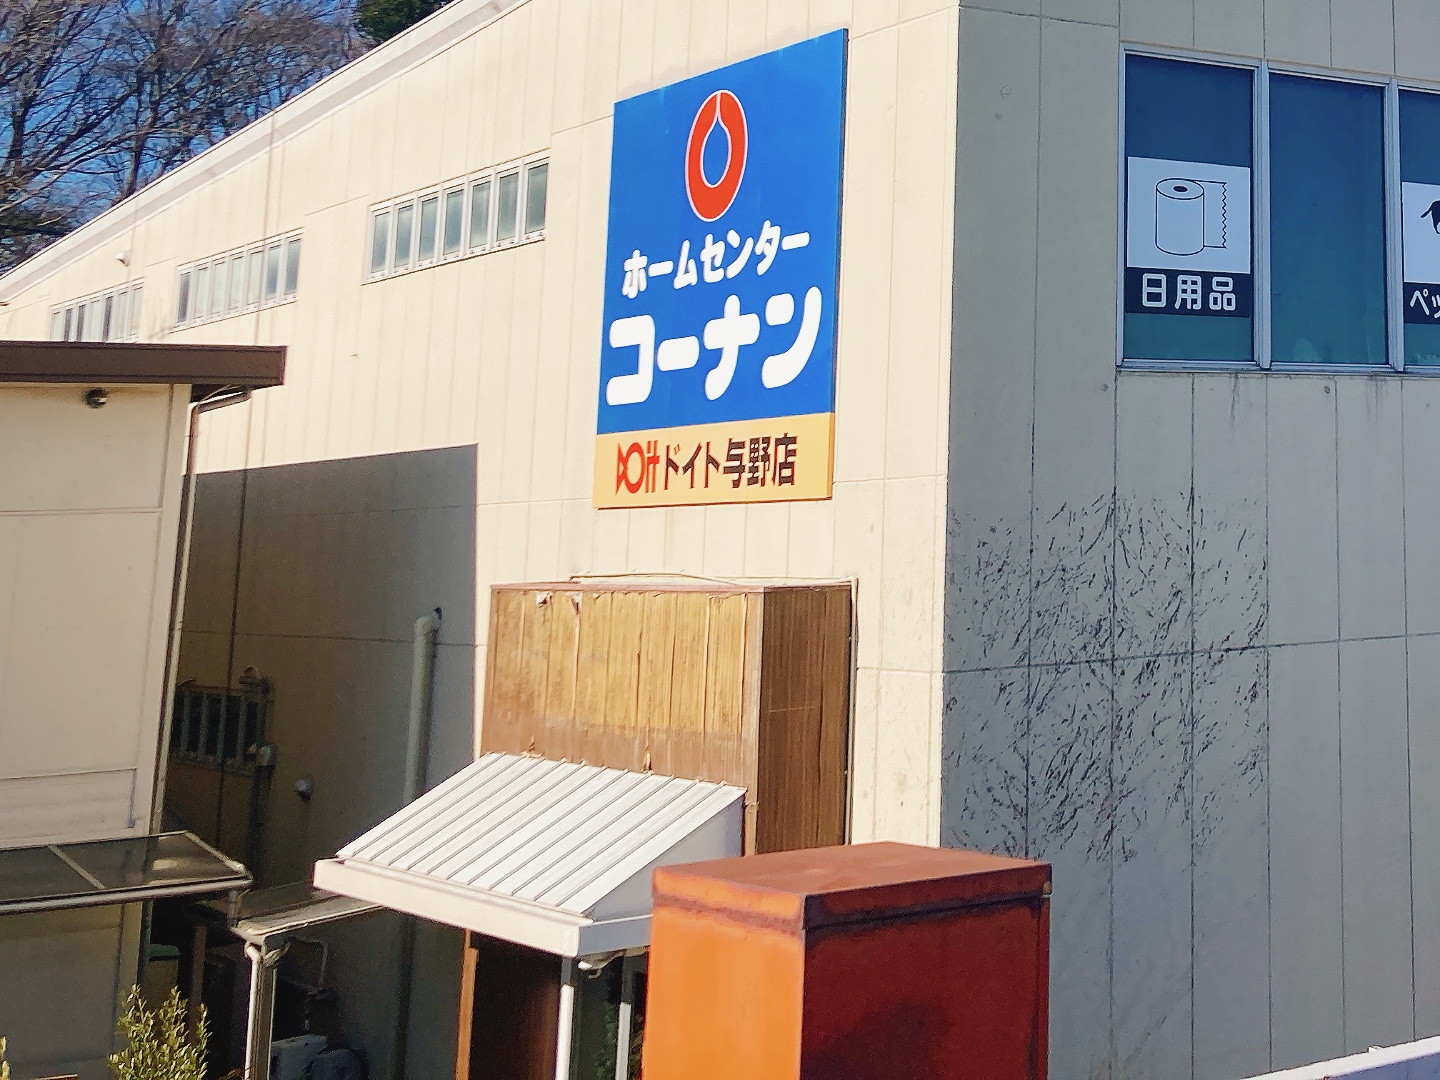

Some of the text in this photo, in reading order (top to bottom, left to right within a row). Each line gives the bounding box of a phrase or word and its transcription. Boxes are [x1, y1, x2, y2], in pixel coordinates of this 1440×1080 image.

[621, 219, 810, 299] ホームセンター
[1142, 273, 1236, 310] 日用品
[606, 286, 822, 406] コーナン
[663, 432, 798, 491] ドイト与野店
